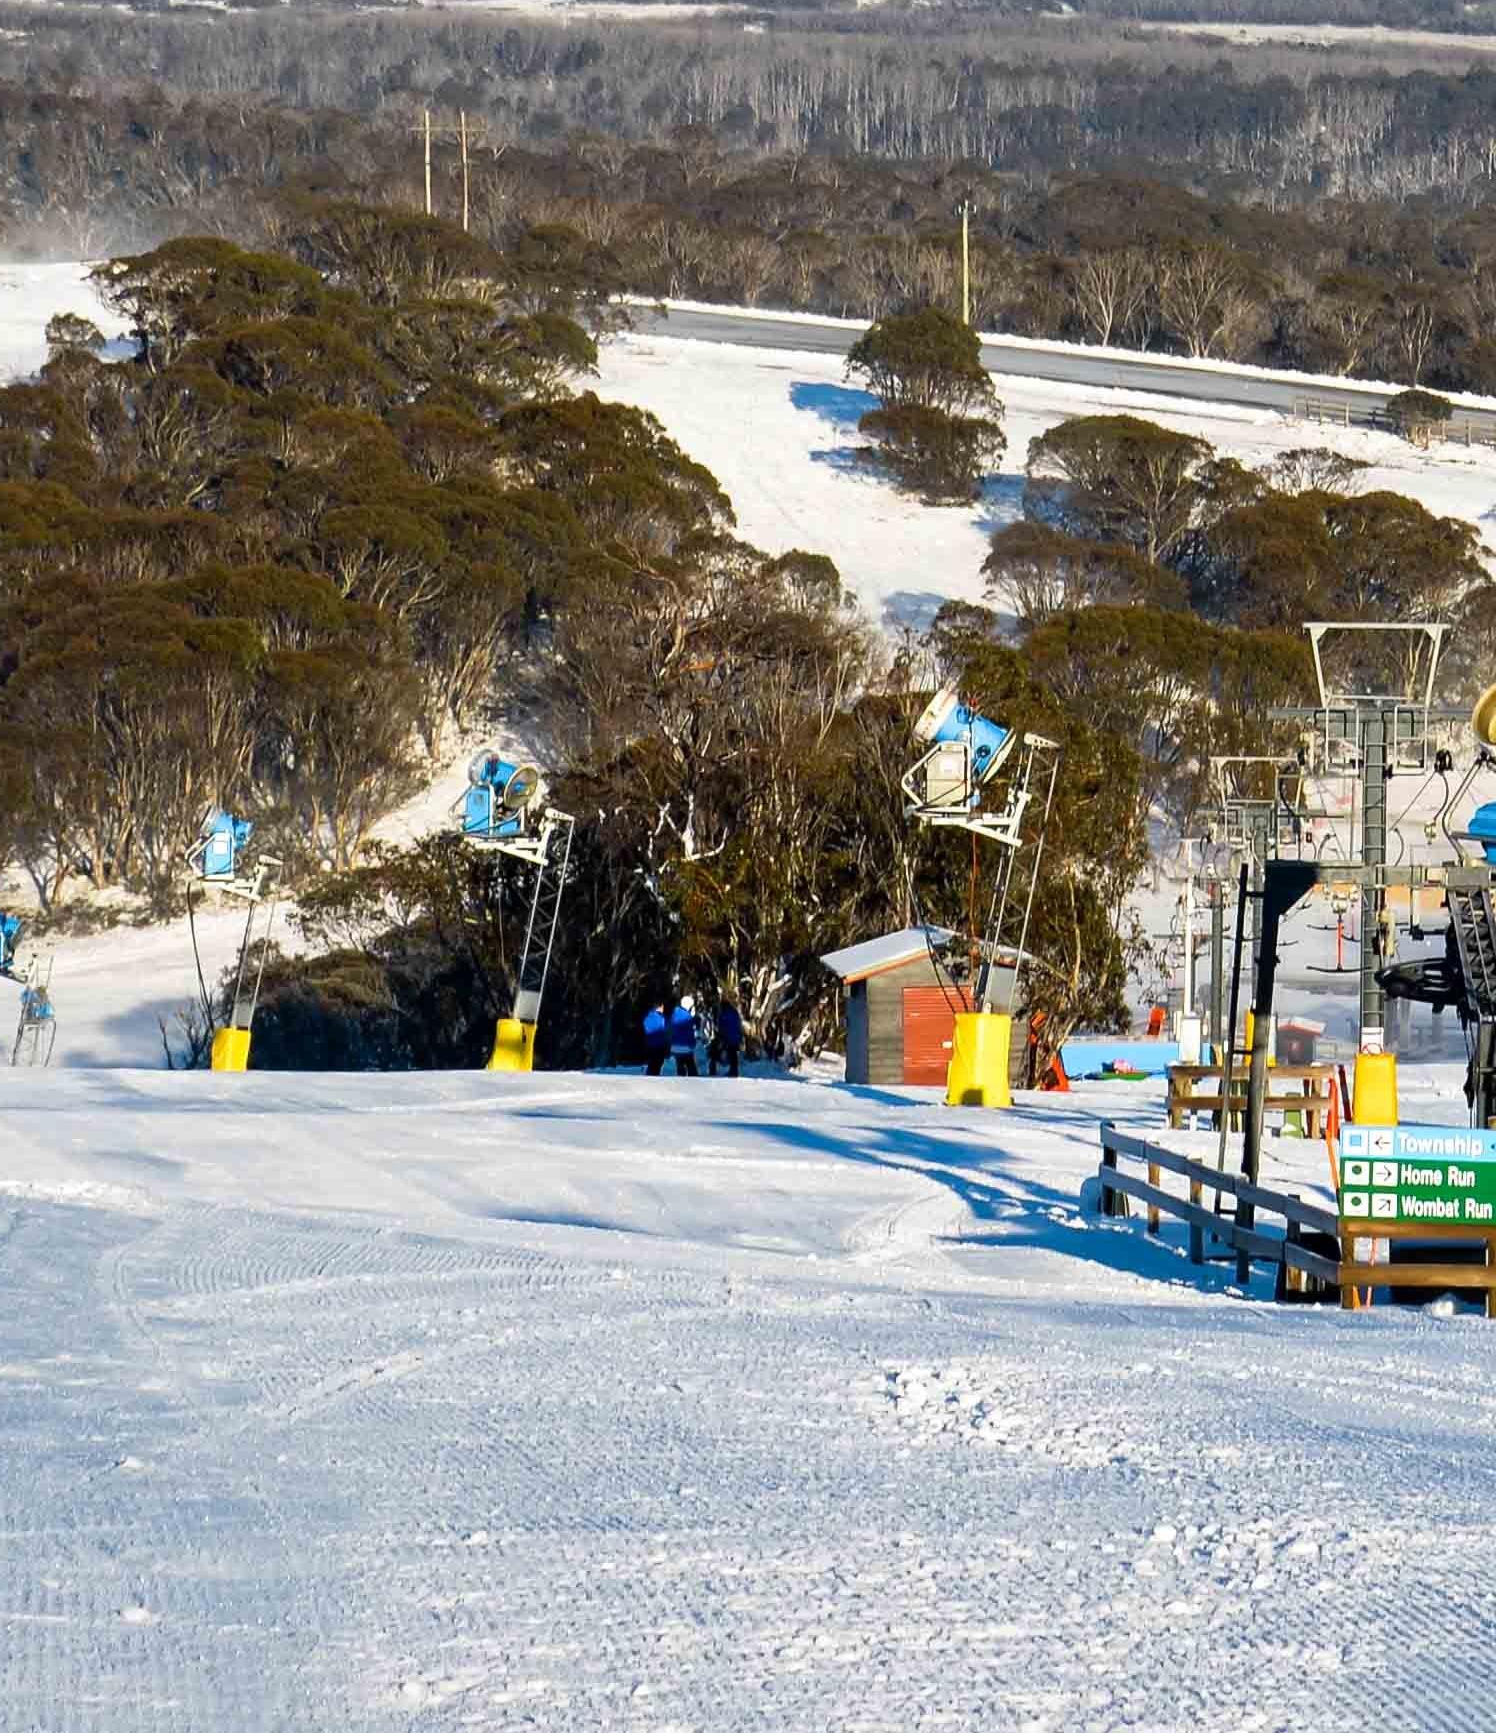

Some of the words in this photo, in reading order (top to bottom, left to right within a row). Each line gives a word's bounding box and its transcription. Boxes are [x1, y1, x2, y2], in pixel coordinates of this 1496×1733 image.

[1399, 1132, 1483, 1157] Township
[1400, 1163, 1443, 1187] Home
[1447, 1165, 1476, 1188] Run
[1401, 1195, 1460, 1218] Wombat
[1464, 1197, 1493, 1220] Run
